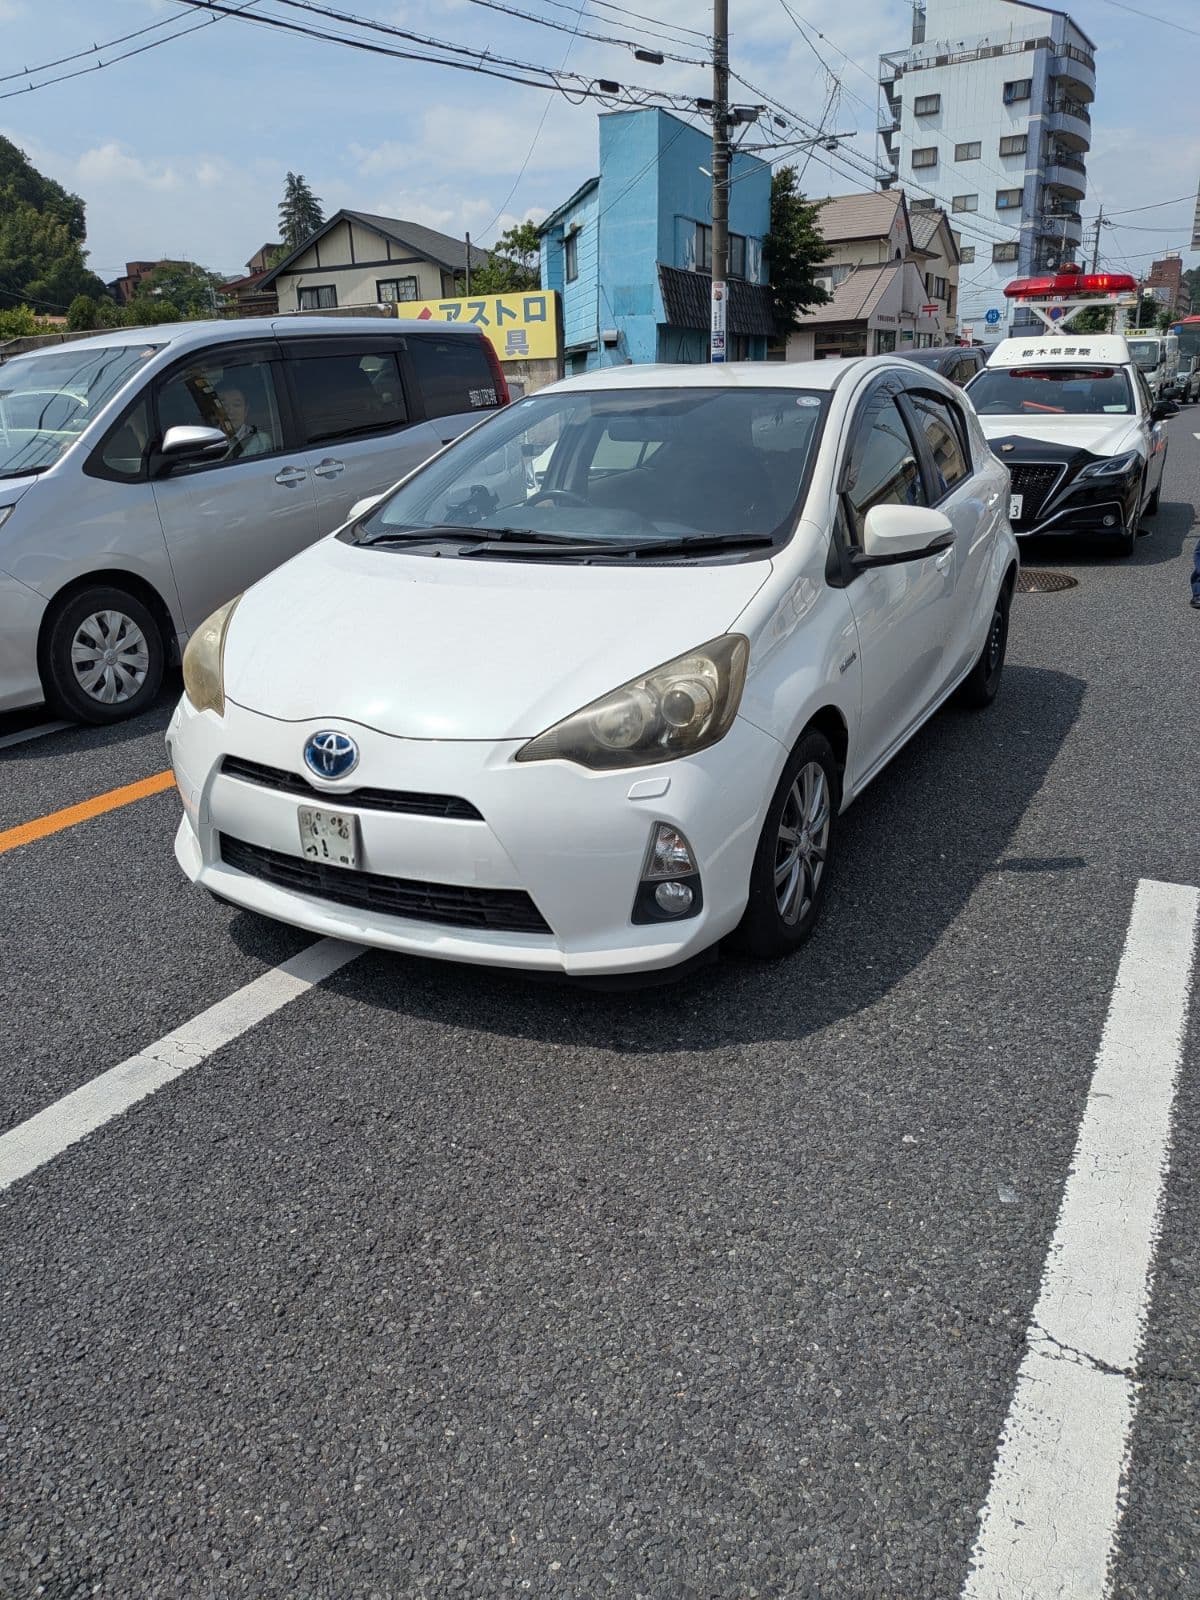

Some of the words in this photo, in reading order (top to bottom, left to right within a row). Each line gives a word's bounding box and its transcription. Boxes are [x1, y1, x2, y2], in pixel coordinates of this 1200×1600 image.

[438, 296, 547, 327] アストロ
[504, 329, 530, 356] 具
[1022, 347, 1092, 358] 栃木県警察
